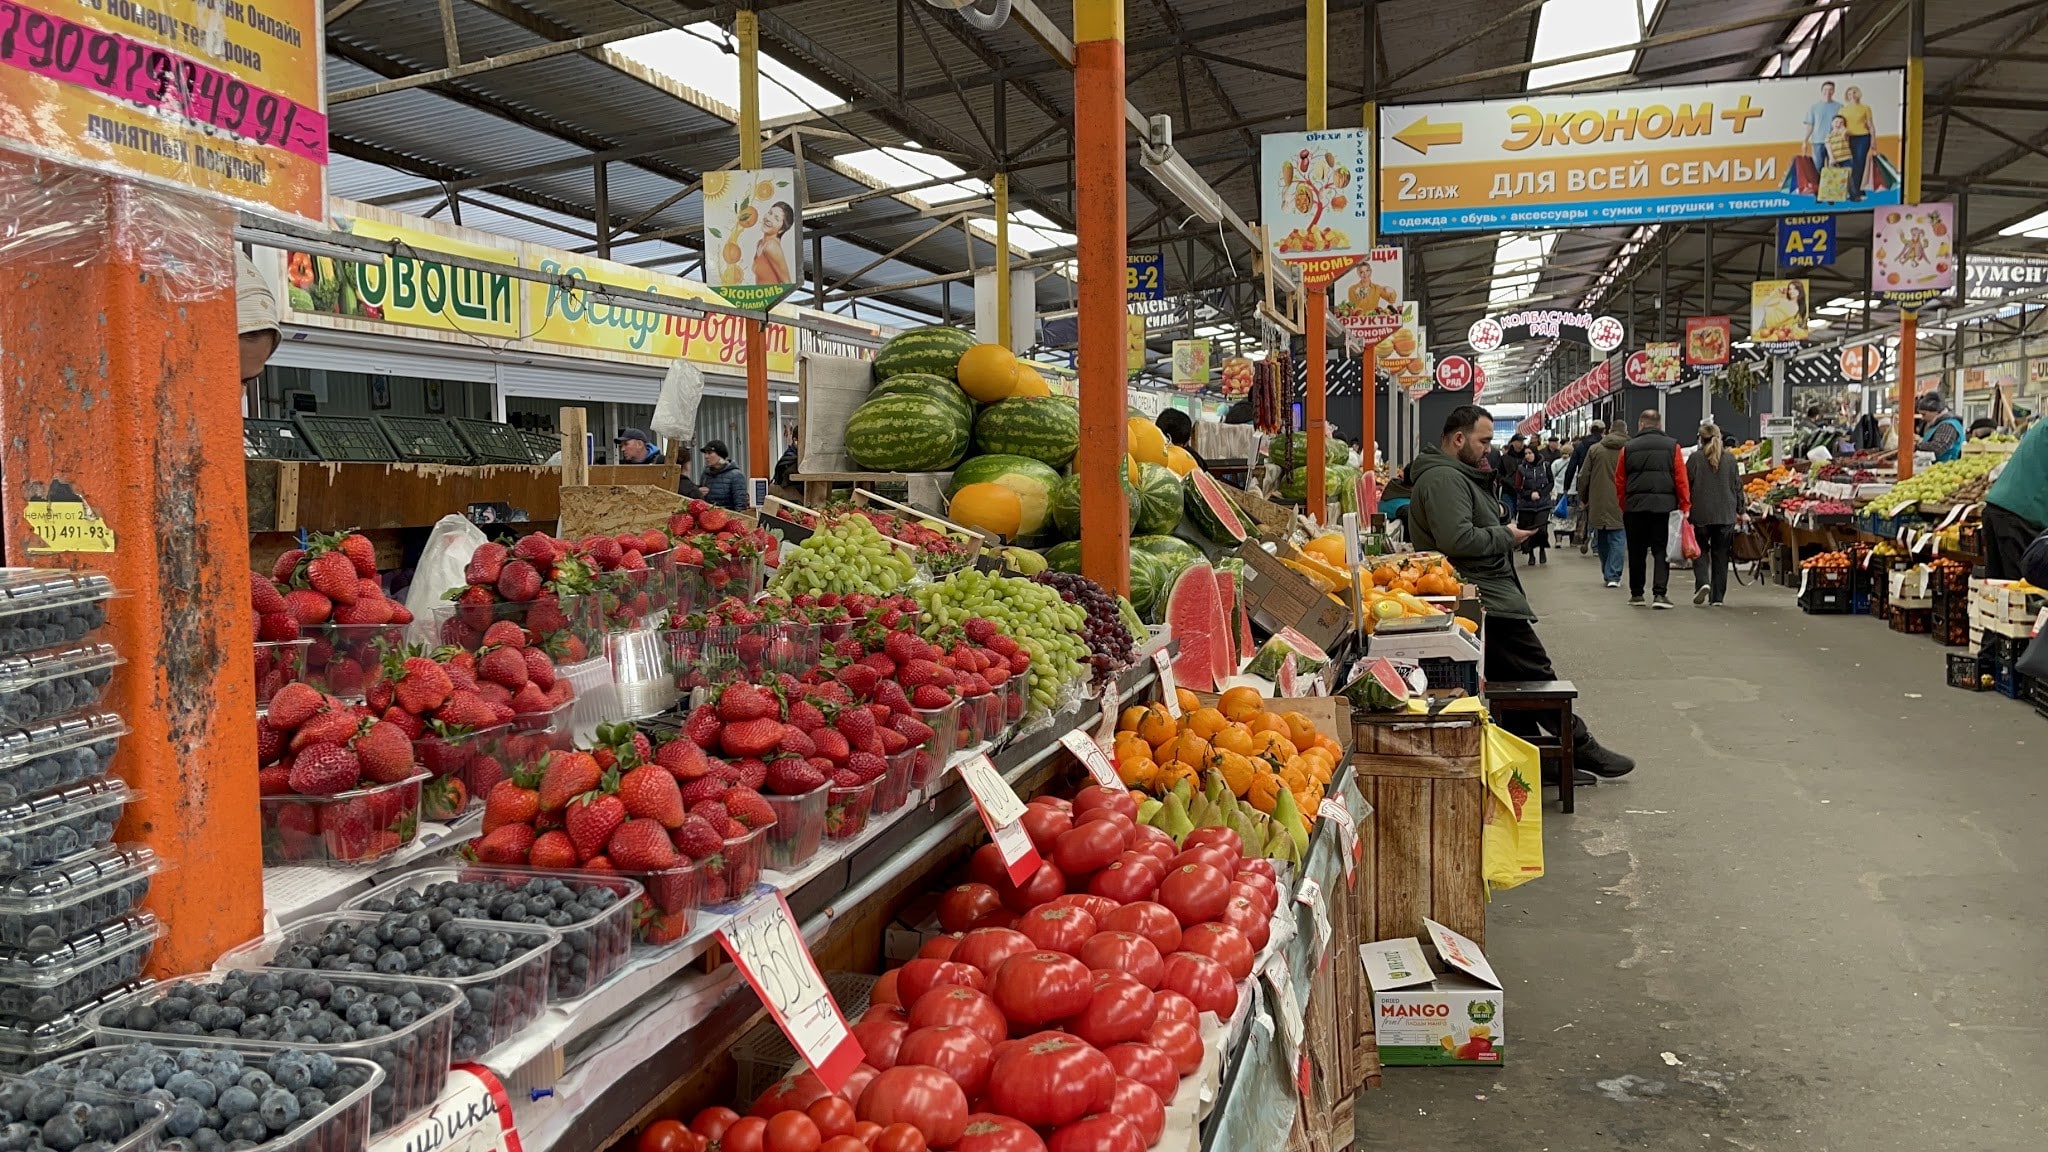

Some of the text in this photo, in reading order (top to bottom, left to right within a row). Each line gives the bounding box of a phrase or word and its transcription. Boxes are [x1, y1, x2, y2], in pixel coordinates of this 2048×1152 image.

[247, 4, 301, 48] Онлайн
[1306, 132, 1341, 142] ОРЕХИ
[1489, 156, 1776, 199] ДЛЯ ВСЕЙ СЕМЬИ
[1399, 199, 1790, 227] одежда обувь аксессуары сумки игрушки текстиль
[1127, 255, 1158, 263] ЕКТОР
[1789, 255, 1824, 266] РЯД 7
[358, 255, 511, 324] ОВОЩИ
[719, 285, 784, 300] ЭКОНОМЬ
[1883, 288, 1940, 300] ЭКОНОМЬ
[1128, 292, 1147, 301] РЯД
[1340, 315, 1399, 326] ФРУКТЫ
[1500, 310, 1593, 330] КОЛБАСНЫЙ
[1529, 323, 1560, 338] РЯД
[664, 310, 790, 365] продут
[1446, 378, 1461, 387] РЯД
[65, 512, 75, 520] от
[1381, 1004, 1449, 1017] MANGO
